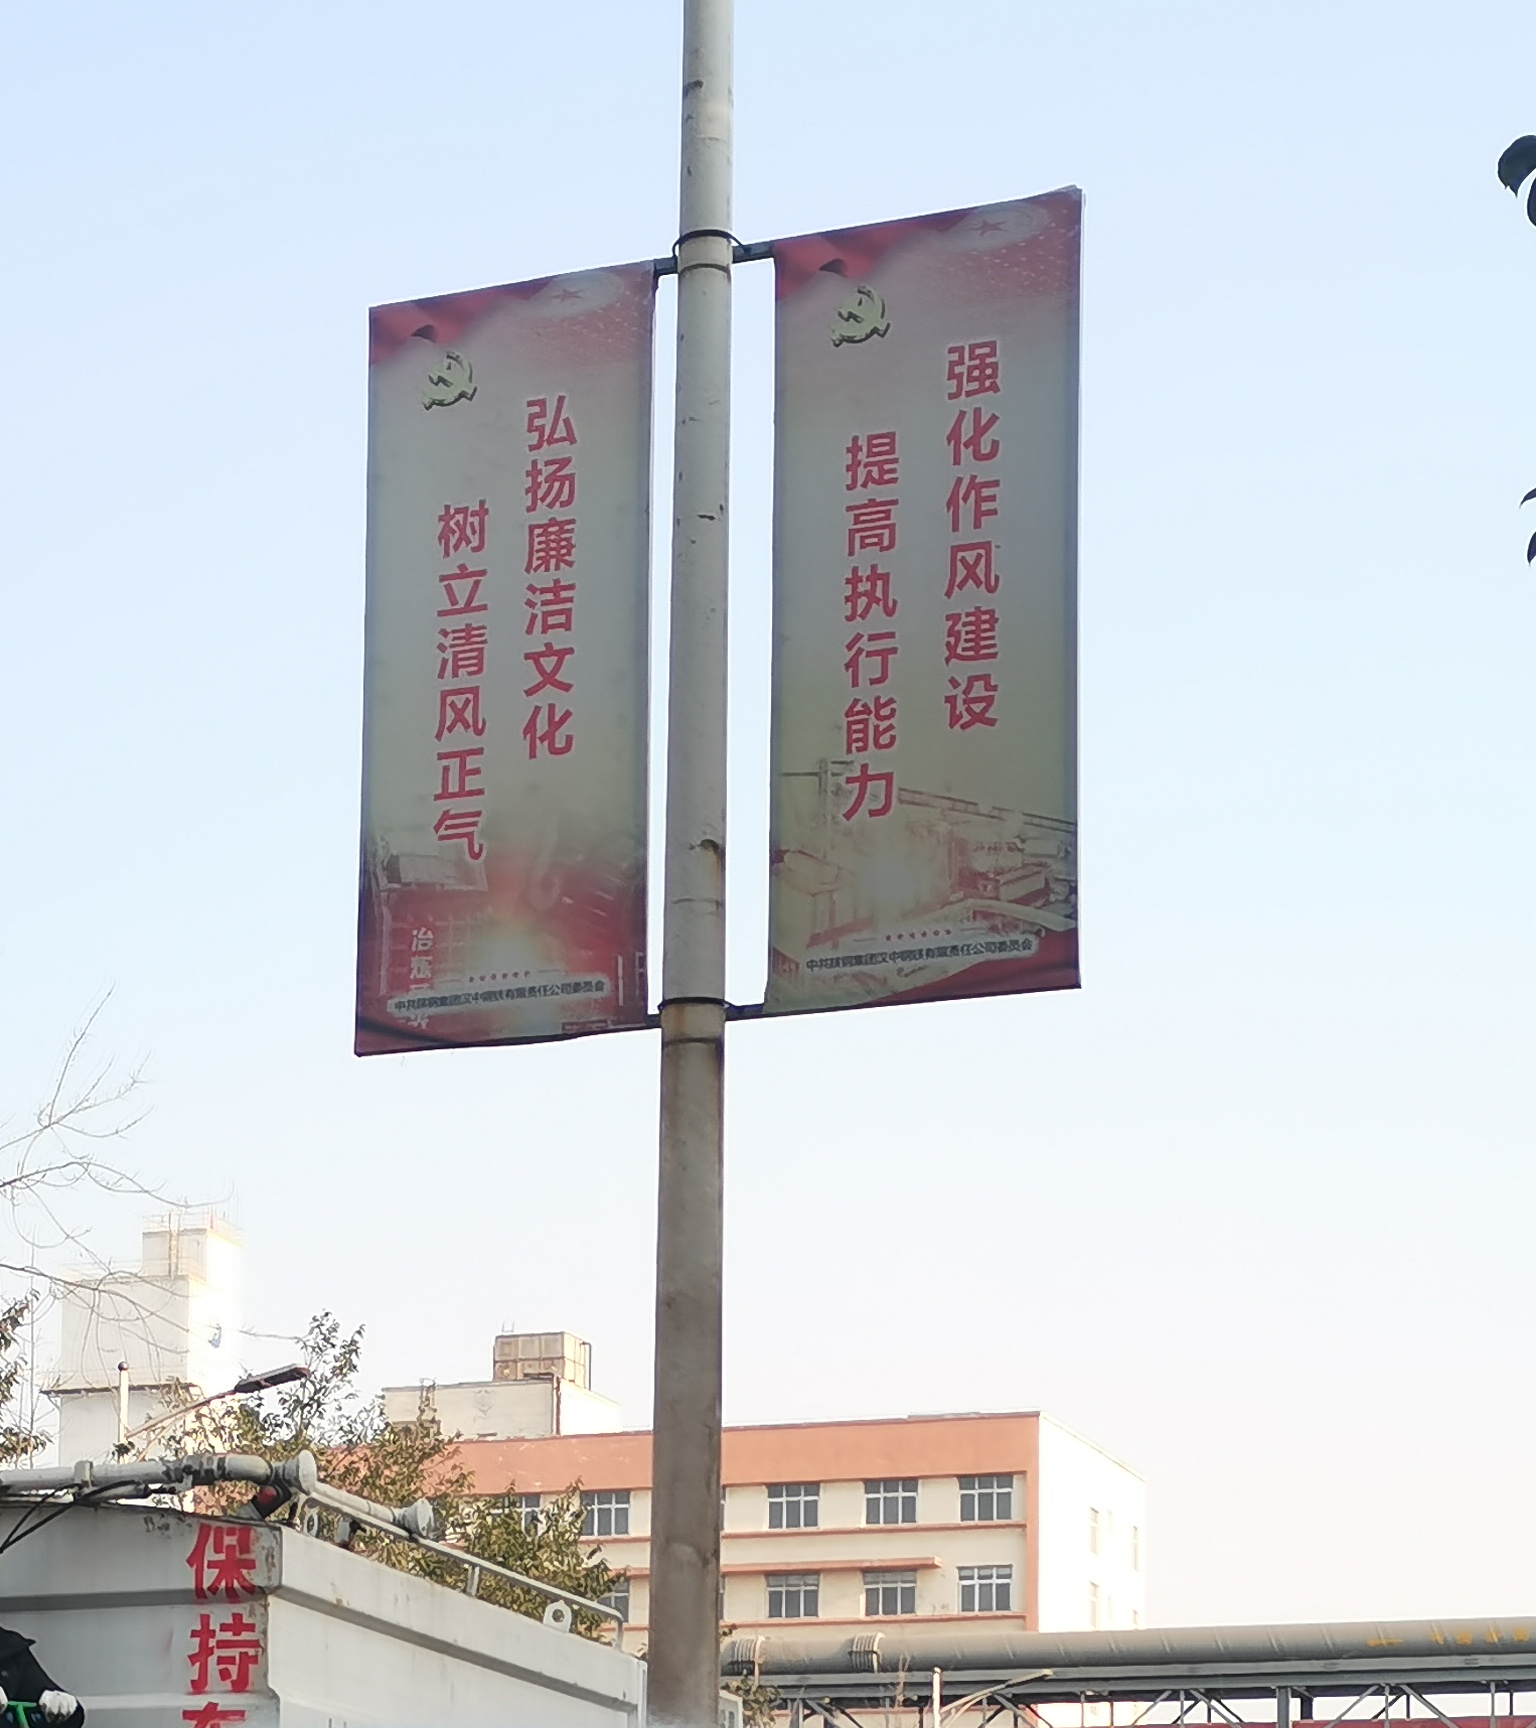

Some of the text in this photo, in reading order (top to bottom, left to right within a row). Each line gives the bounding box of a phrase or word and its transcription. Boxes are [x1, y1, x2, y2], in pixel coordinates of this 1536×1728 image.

[432, 501, 490, 862] 树立清风正气
[522, 395, 576, 760] 弘扬廉洁文化
[842, 432, 901, 823] 提高执行能力
[944, 340, 1002, 732] 强化作风建设
